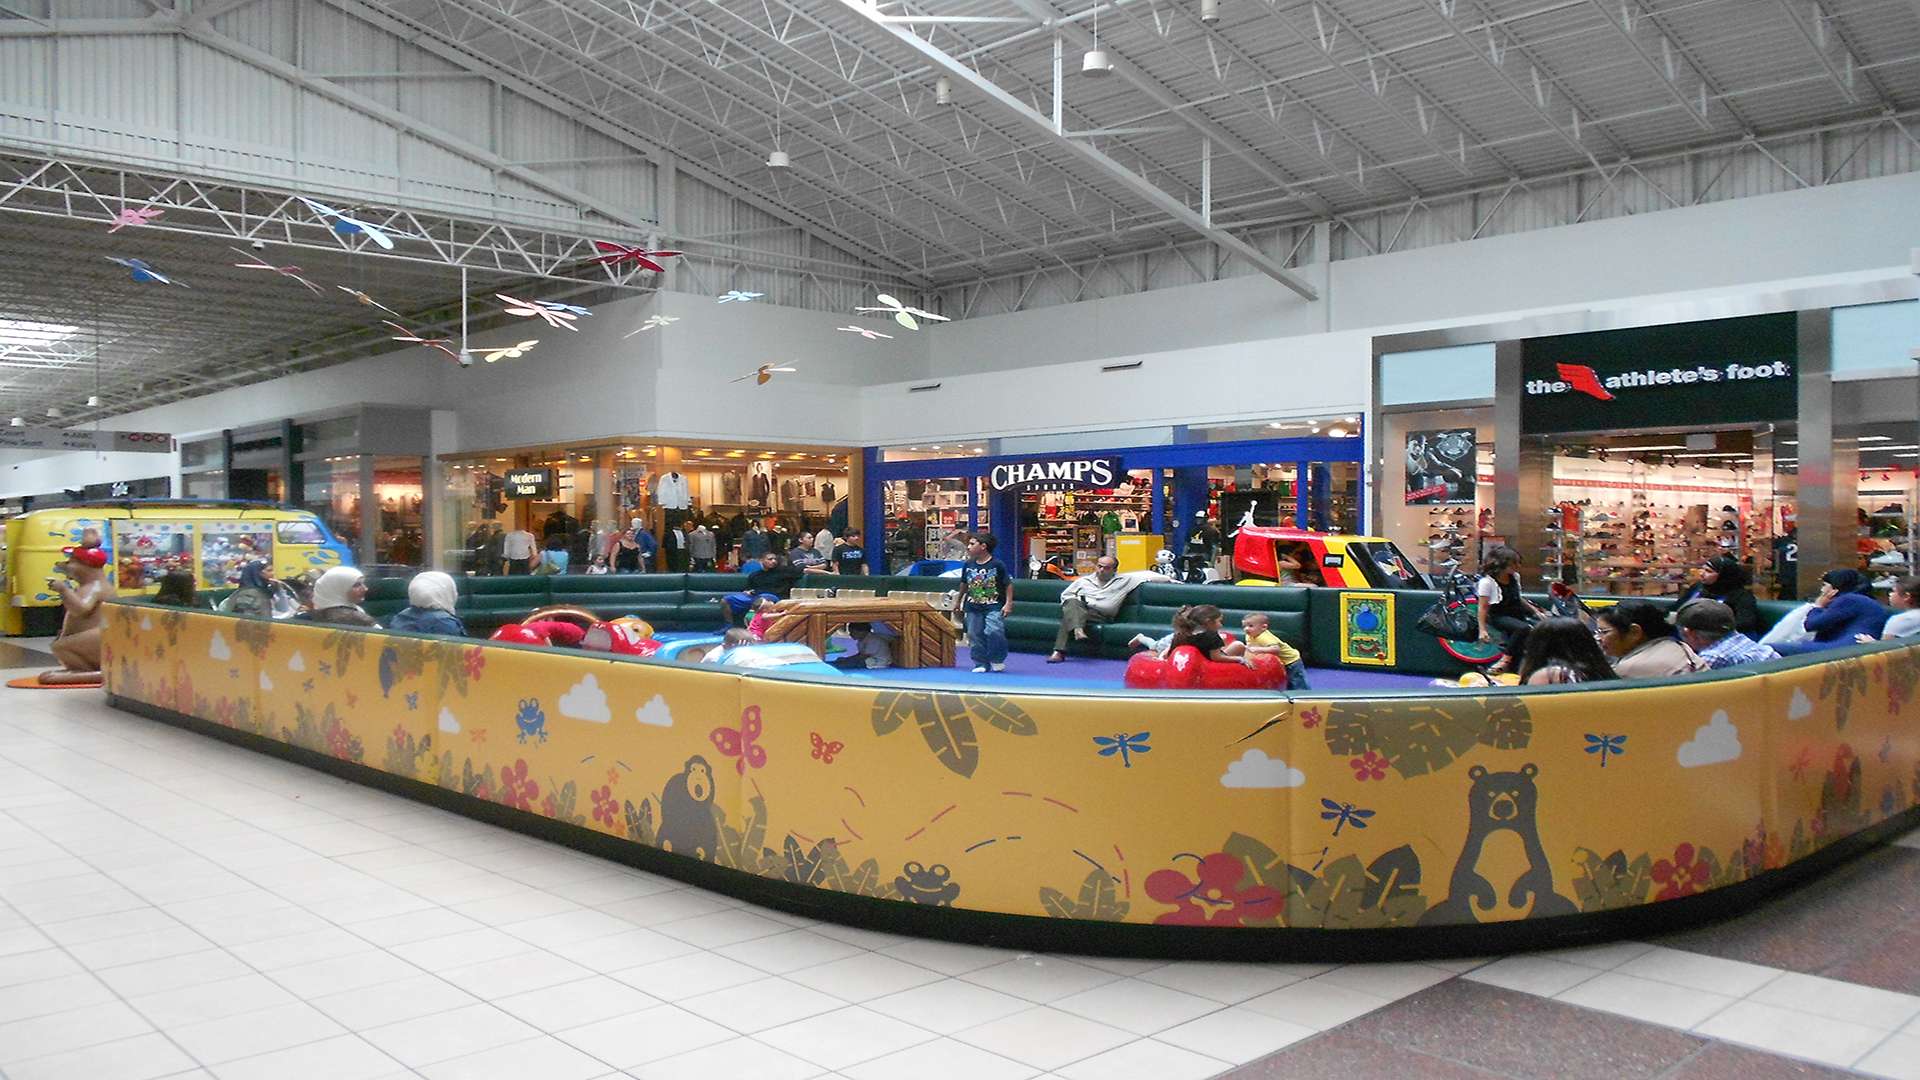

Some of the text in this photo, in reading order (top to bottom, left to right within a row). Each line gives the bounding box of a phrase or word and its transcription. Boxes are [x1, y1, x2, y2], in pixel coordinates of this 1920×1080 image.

[1526, 361, 1788, 395] the athlete's foot
[510, 473, 543, 484] Modern
[991, 459, 1113, 490] CHAMPS
[516, 485, 536, 495] Man
